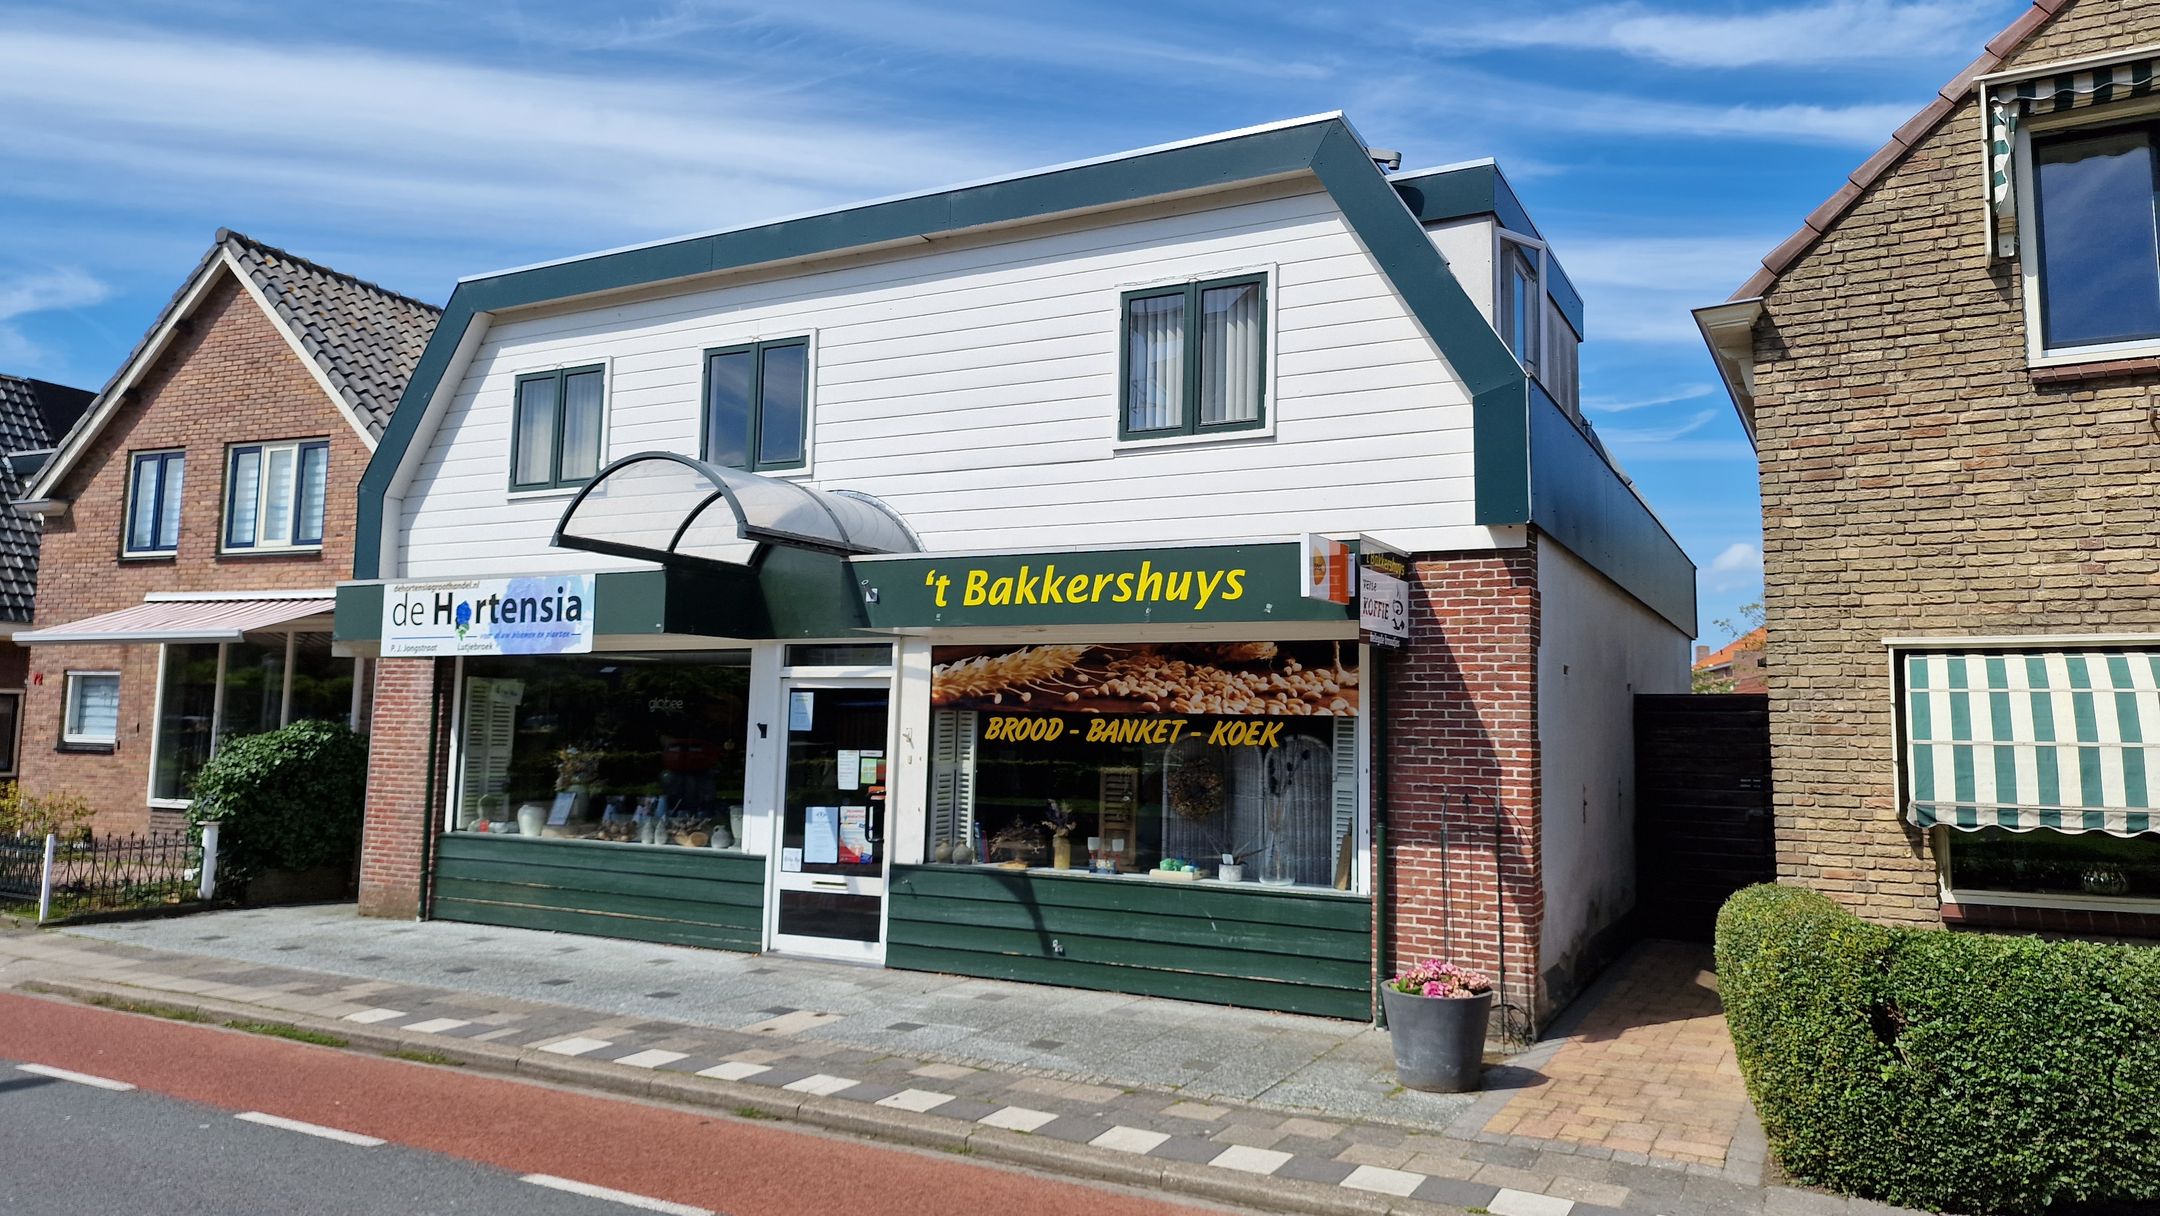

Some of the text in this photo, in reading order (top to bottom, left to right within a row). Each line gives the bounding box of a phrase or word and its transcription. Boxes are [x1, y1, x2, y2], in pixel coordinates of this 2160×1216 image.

[963, 560, 1246, 610] Bakkershuys
[393, 593, 424, 627] de
[1362, 597, 1390, 621] KOFFIE
[985, 717, 1063, 742] BROOD
[1086, 718, 1188, 744] BANKET
[1208, 720, 1284, 748] KOEK
